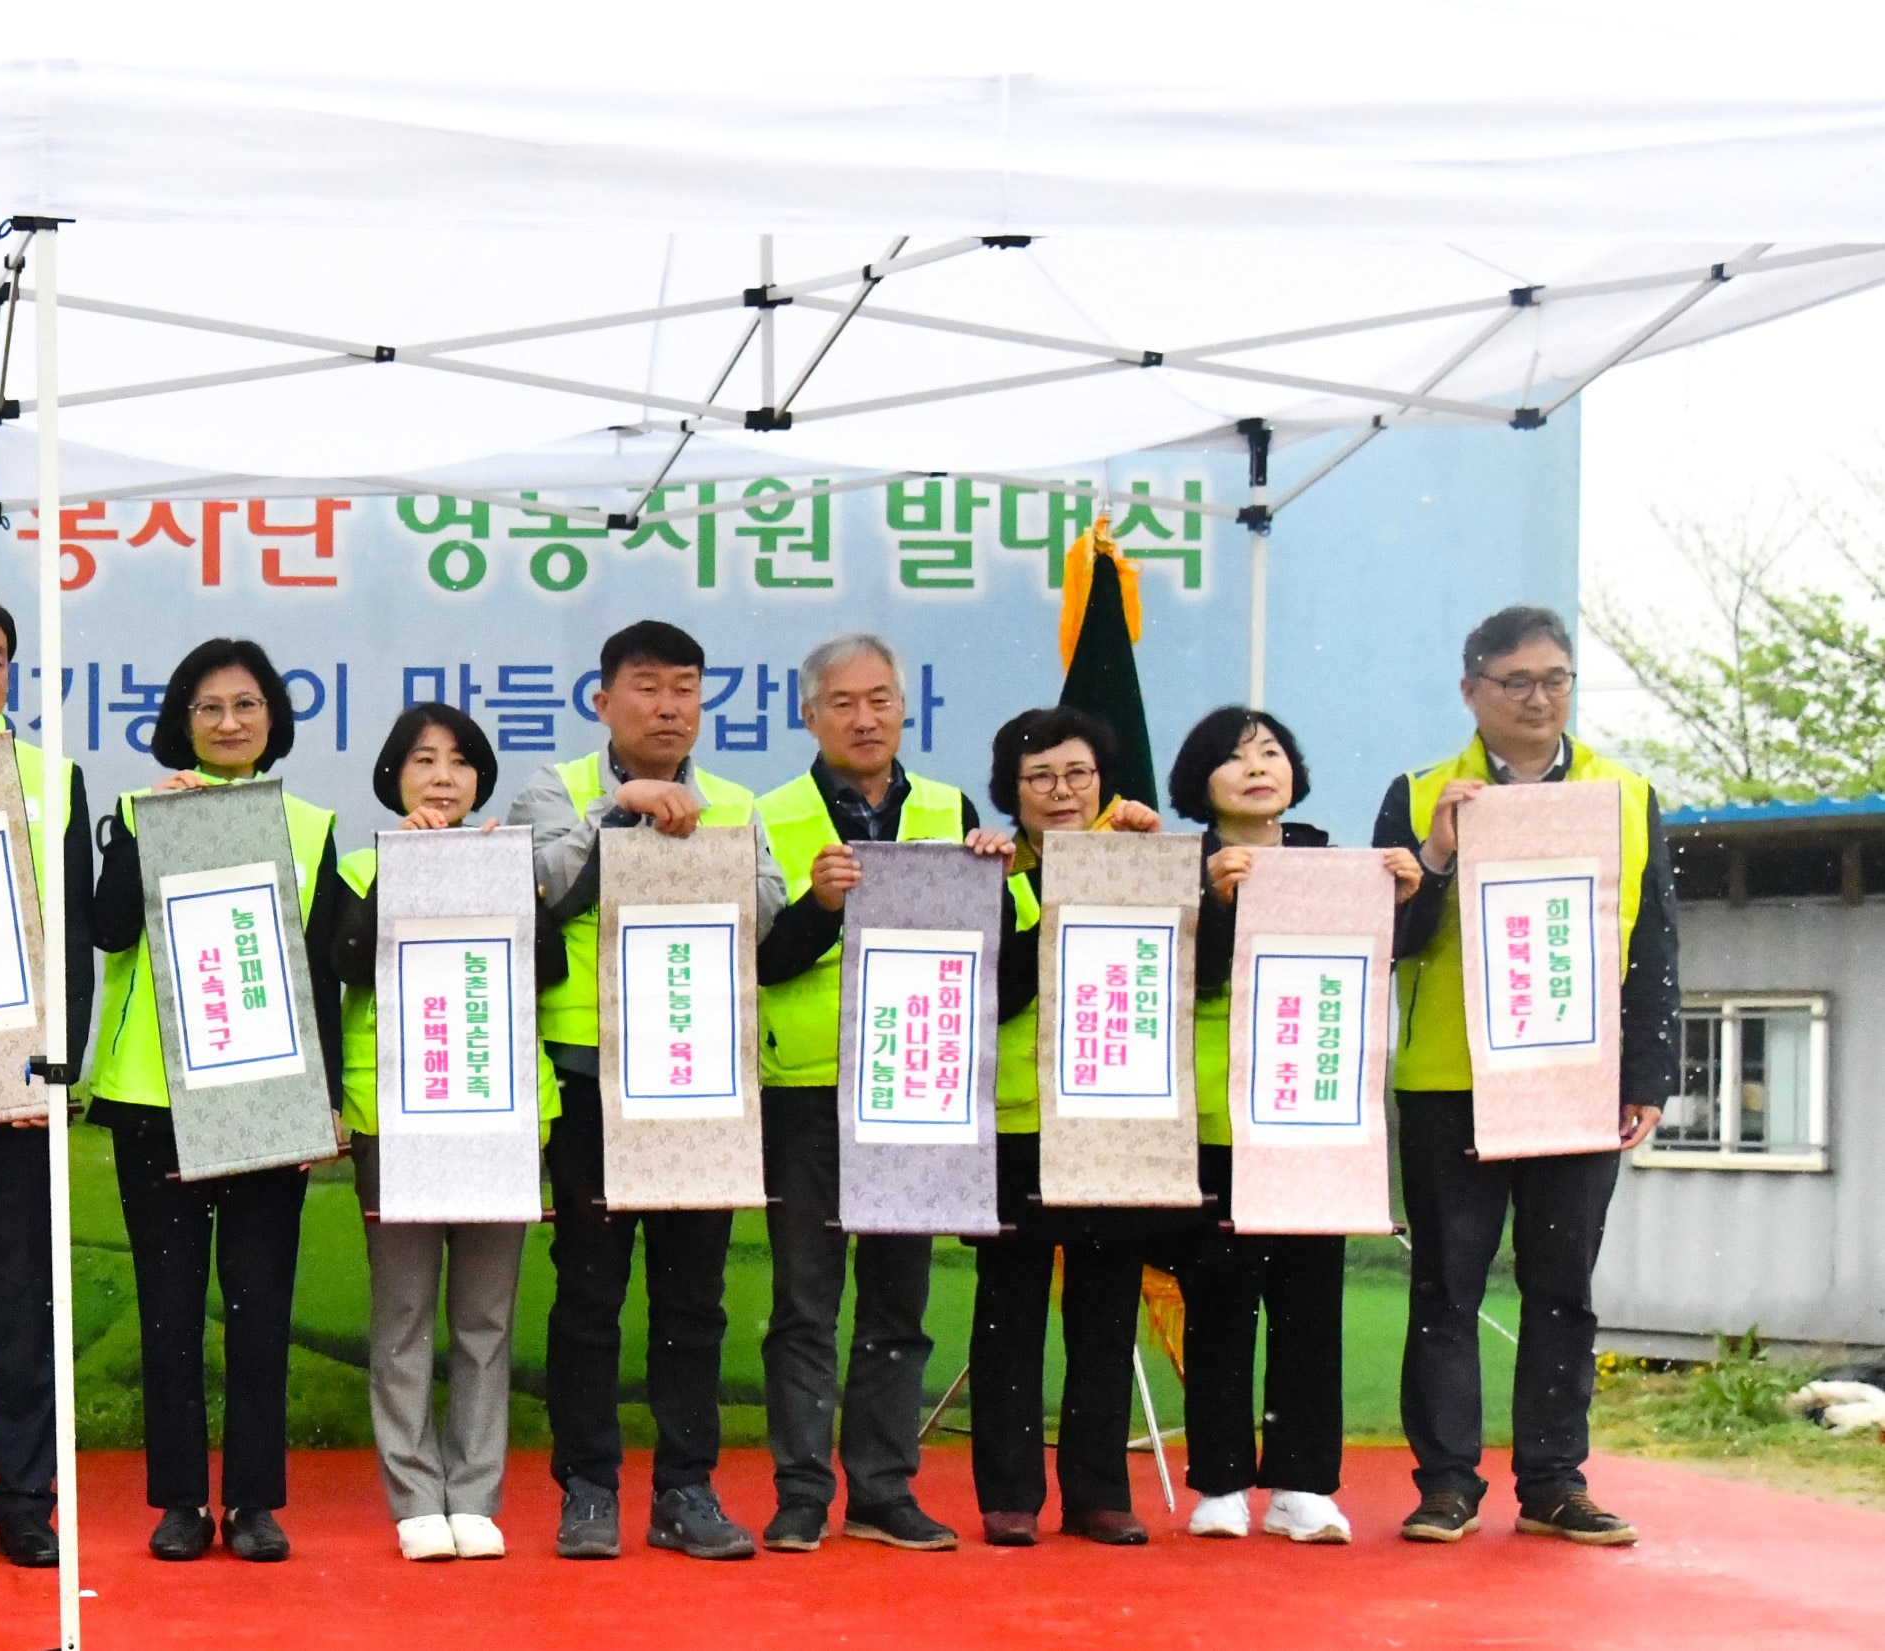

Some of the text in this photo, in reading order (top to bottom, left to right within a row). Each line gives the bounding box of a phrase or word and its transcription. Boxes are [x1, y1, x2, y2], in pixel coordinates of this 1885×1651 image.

[16, 498, 352, 591] 봉사단
[396, 477, 833, 592] 영농지원
[885, 478, 1202, 590] 발대식
[198, 947, 231, 1051] 신속복구
[232, 906, 267, 1009] 농업재해
[1135, 937, 1158, 1039] 농촌인력
[1545, 897, 1572, 1022] 희망농업!
[423, 996, 449, 1100] 완벽해결
[465, 951, 490, 1098] 농촌일손부족
[666, 943, 692, 1085] 청년농부 육성
[871, 1006, 898, 1110] 경기농협
[904, 994, 930, 1098] 하나되는
[935, 959, 963, 1113] 변화의중심!
[1074, 984, 1099, 1086] 운영지원
[1103, 964, 1129, 1066] 중개센터
[1274, 996, 1301, 1110] 절감 추진
[1315, 973, 1342, 1101] 농업경영비
